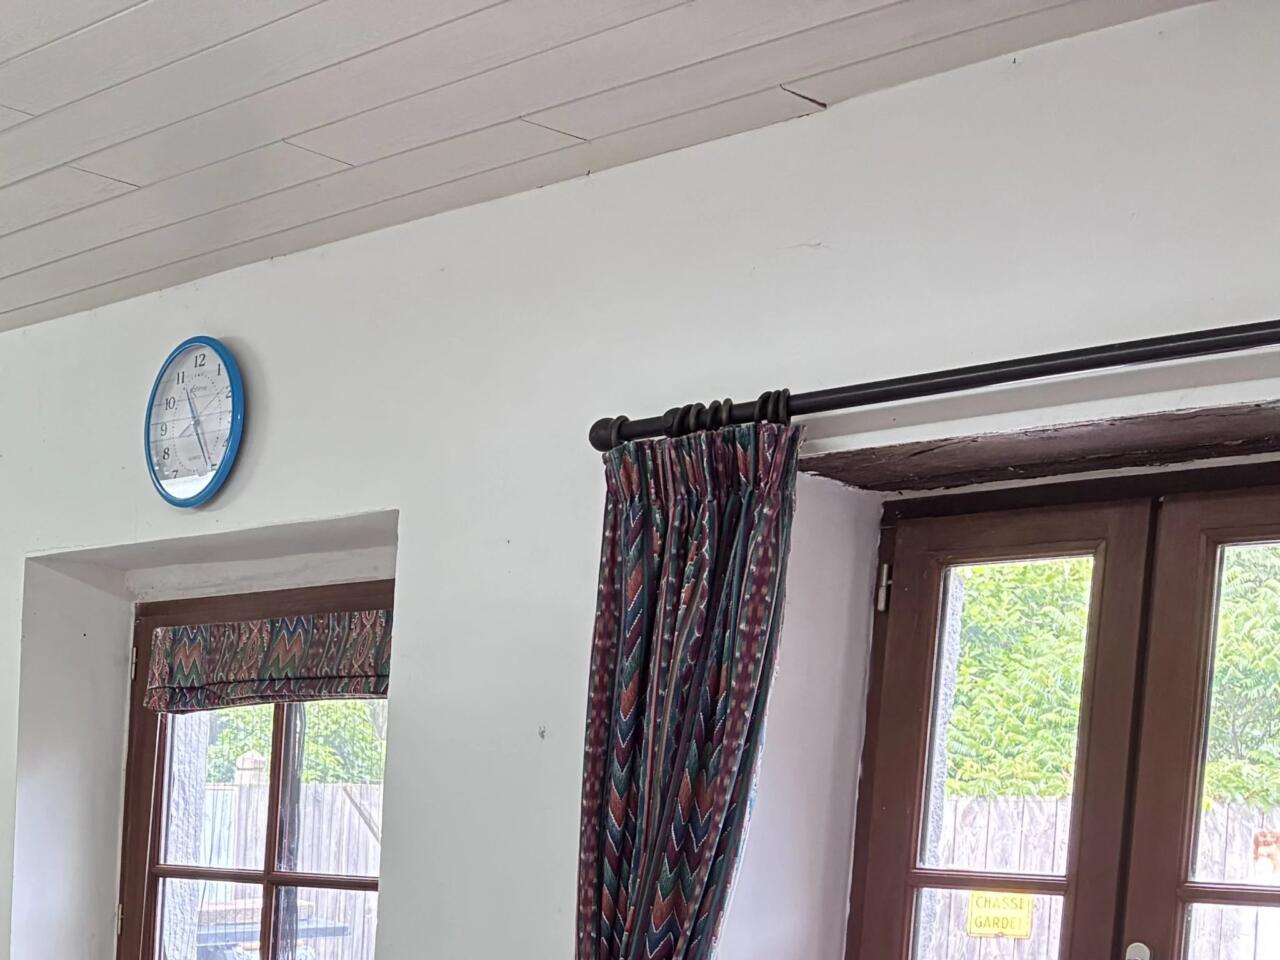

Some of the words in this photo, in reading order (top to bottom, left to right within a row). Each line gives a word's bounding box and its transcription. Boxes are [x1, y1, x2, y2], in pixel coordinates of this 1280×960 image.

[193, 353, 207, 368] 12
[217, 362, 221, 376] 1
[176, 371, 186, 385] 11
[164, 397, 176, 411] 10
[159, 422, 168, 437] 9
[162, 447, 170, 461] 8
[171, 469, 179, 480] 7
